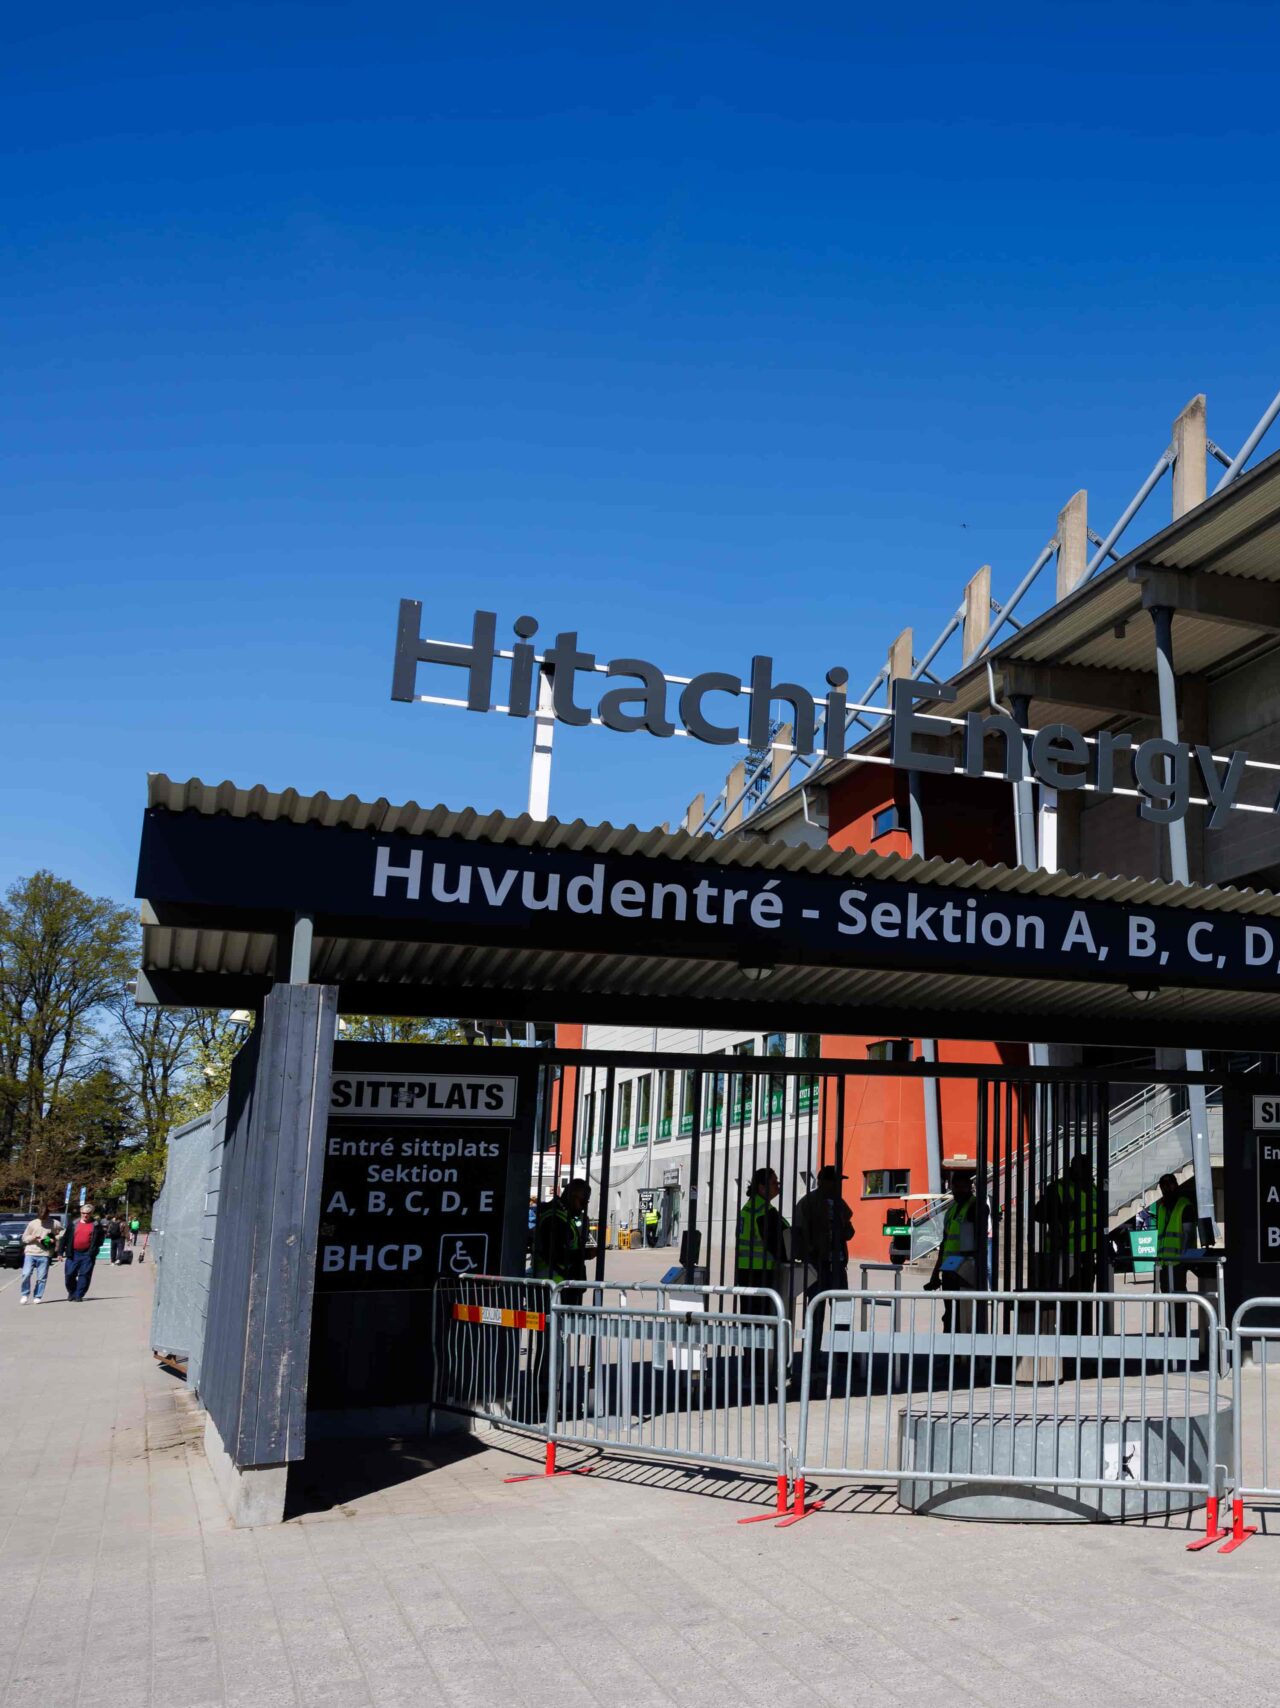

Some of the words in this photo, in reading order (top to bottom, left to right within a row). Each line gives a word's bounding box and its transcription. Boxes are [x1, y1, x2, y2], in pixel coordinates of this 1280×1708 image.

[391, 598, 850, 759] Hitachi
[891, 677, 1250, 829] Energy
[372, 845, 783, 929] Huvudentré
[837, 889, 1045, 949] Sektion
[1061, 912, 1109, 961] A,
[1128, 916, 1170, 966] B,
[1187, 921, 1227, 969] C,
[331, 1080, 504, 1110] SITTPLATS
[328, 1137, 394, 1156] Entré
[401, 1138, 500, 1162] sittplats
[366, 1164, 458, 1183] Sektion
[326, 1191, 357, 1216] A,
[367, 1191, 394, 1216] B,
[404, 1191, 430, 1216] C,
[441, 1191, 468, 1216] D,
[479, 1191, 494, 1212] E
[322, 1244, 423, 1272] BHCP
